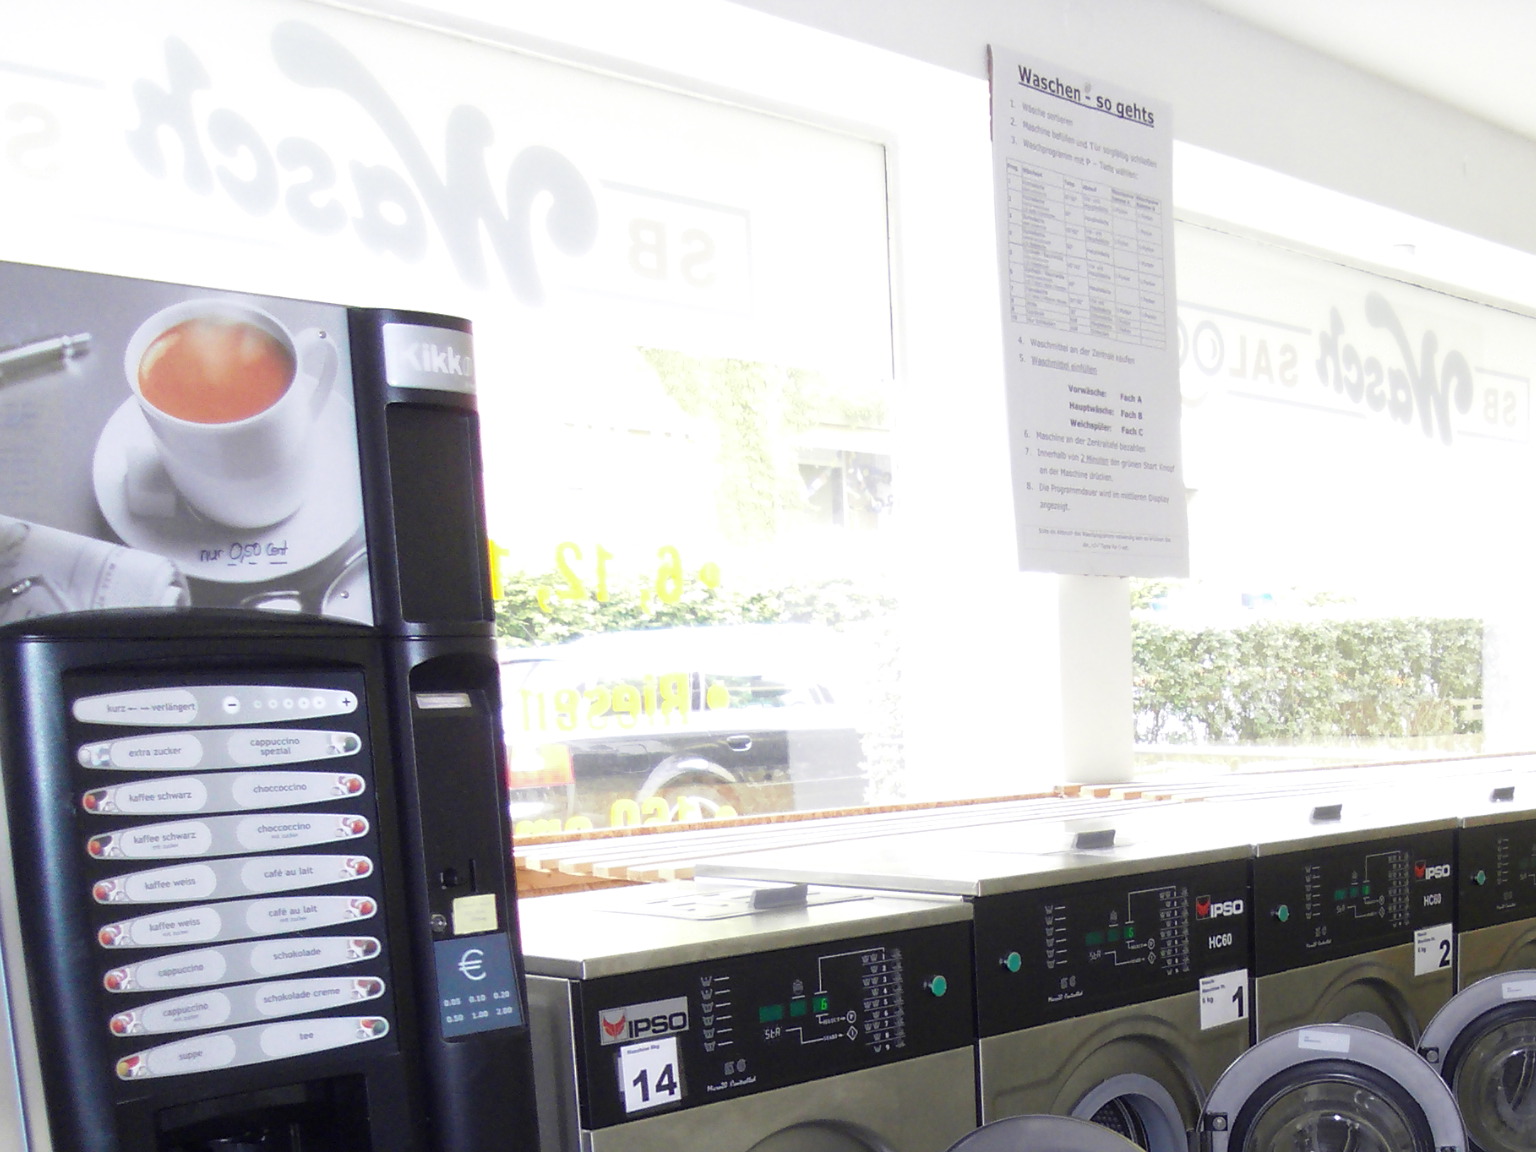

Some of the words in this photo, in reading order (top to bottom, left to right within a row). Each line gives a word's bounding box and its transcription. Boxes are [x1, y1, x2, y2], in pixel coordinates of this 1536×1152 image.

[1018, 64, 1081, 102] Waschen
[1096, 95, 1112, 111] so
[1116, 102, 1155, 125] gehts
[1120, 393, 1135, 403] Fach
[1137, 395, 1142, 404] A
[1121, 409, 1136, 420] Fach
[1121, 426, 1137, 436] Fach
[1138, 428, 1144, 437] C
[200, 547, 224, 562] nur
[107, 704, 126, 712] kurz
[151, 702, 195, 713] verlängert
[250, 738, 300, 747] cappuccino
[128, 748, 151, 757] extra
[153, 746, 182, 756] zucker
[260, 747, 291, 757] spezial
[253, 783, 307, 793] choccoccino
[129, 792, 154, 803] kaffee
[156, 790, 192, 801] schwarz
[257, 822, 311, 833] choccoccino
[133, 834, 160, 845] kaffee
[162, 831, 197, 842] schwarz
[264, 868, 283, 879] café
[285, 869, 297, 877] au
[299, 866, 314, 875] lait
[1425, 864, 1450, 880] IPSO
[144, 880, 171, 891] kaffee
[173, 877, 196, 888] weiss
[268, 907, 287, 917] café
[289, 907, 300, 916] au
[302, 905, 318, 914] lait
[1210, 899, 1244, 918] IPSO
[149, 920, 176, 932] kaffee
[177, 918, 201, 929] weiss
[1208, 933, 1232, 949] HC60
[273, 947, 322, 961] schokolade
[1439, 939, 1450, 968] 2
[158, 963, 204, 978] cappuccino
[263, 990, 311, 1004] schokolade
[313, 987, 340, 998] creme
[1232, 985, 1244, 1018] 1
[163, 1002, 209, 1017] cappuccino
[628, 1012, 687, 1038] IPSO
[299, 1031, 314, 1040] tee
[633, 1064, 677, 1101] 14
